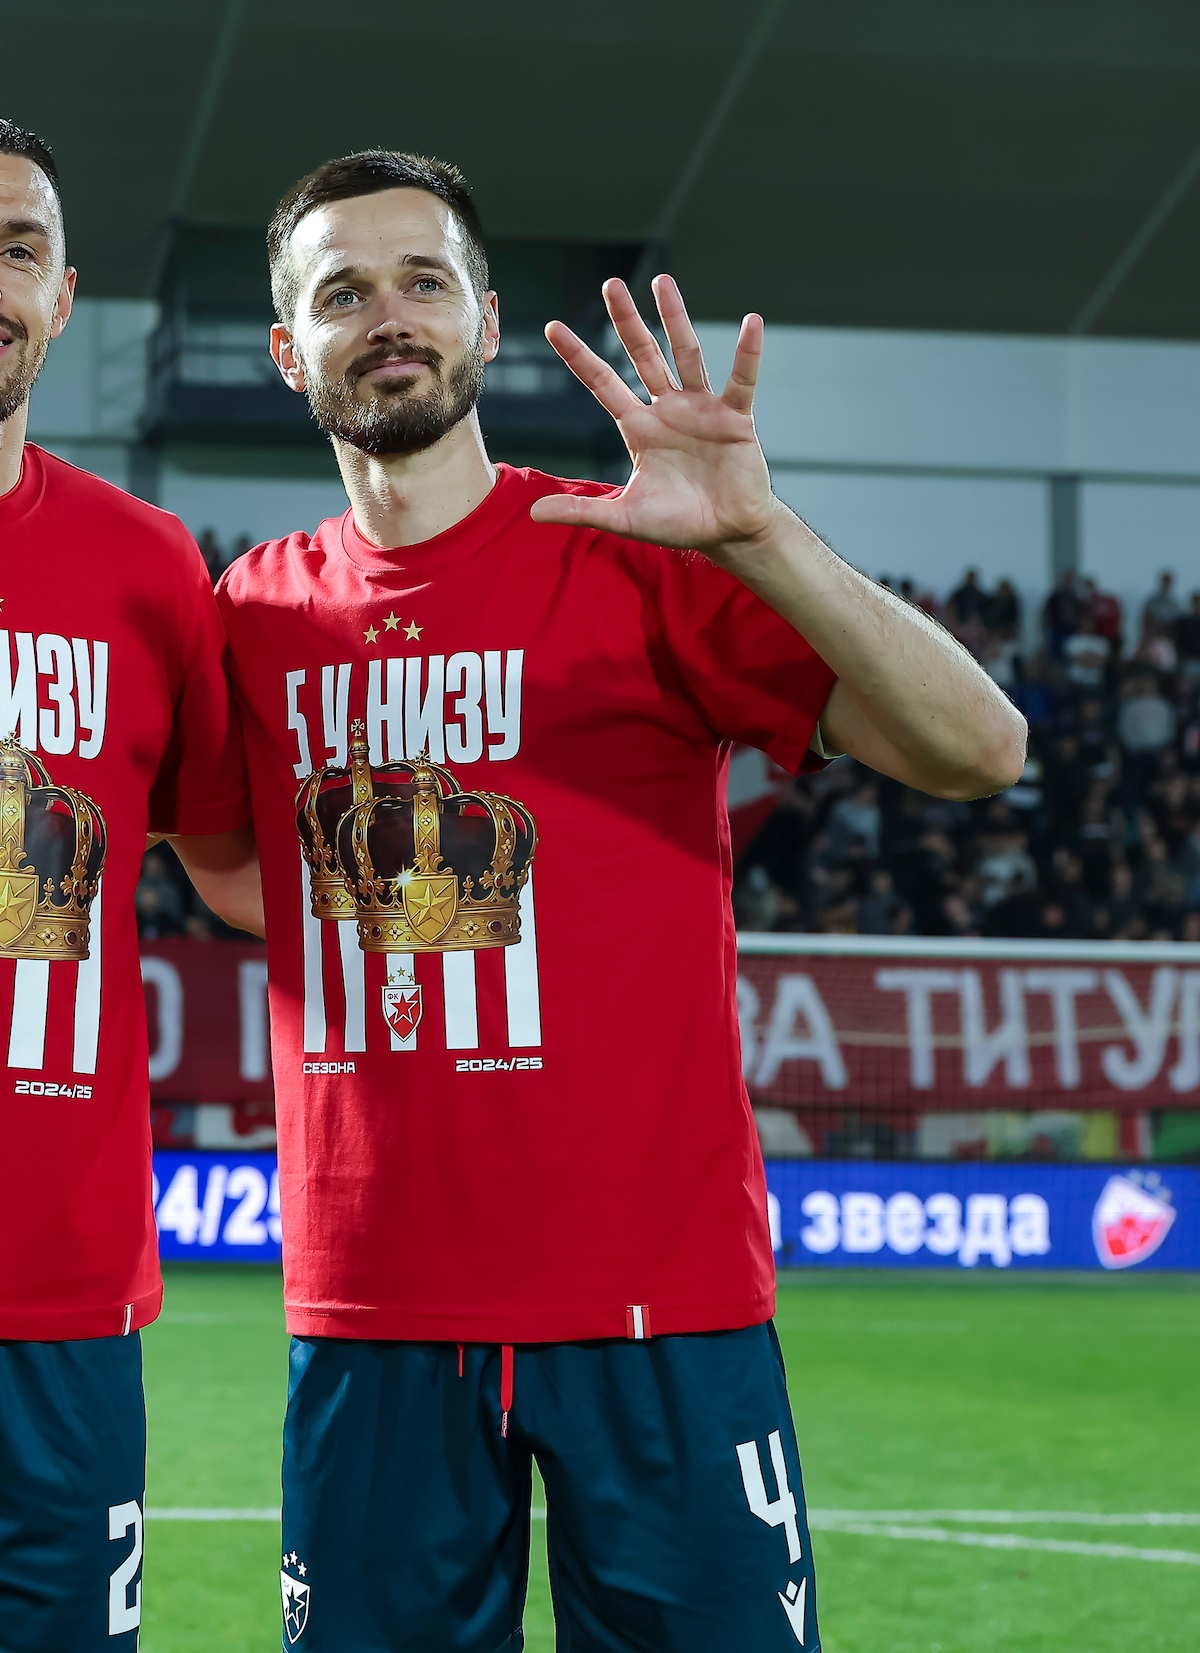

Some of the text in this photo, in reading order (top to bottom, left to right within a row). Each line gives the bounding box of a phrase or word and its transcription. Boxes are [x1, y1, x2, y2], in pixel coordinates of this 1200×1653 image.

[285, 649, 526, 780] 5 У НИЗУ
[386, 992, 399, 1000] ФК
[14, 1079, 93, 1101] 2024/25
[301, 1056, 544, 1075] СЕЗОНА 2024/25
[801, 1190, 1052, 1268] звезда
[735, 1429, 803, 1566] 4
